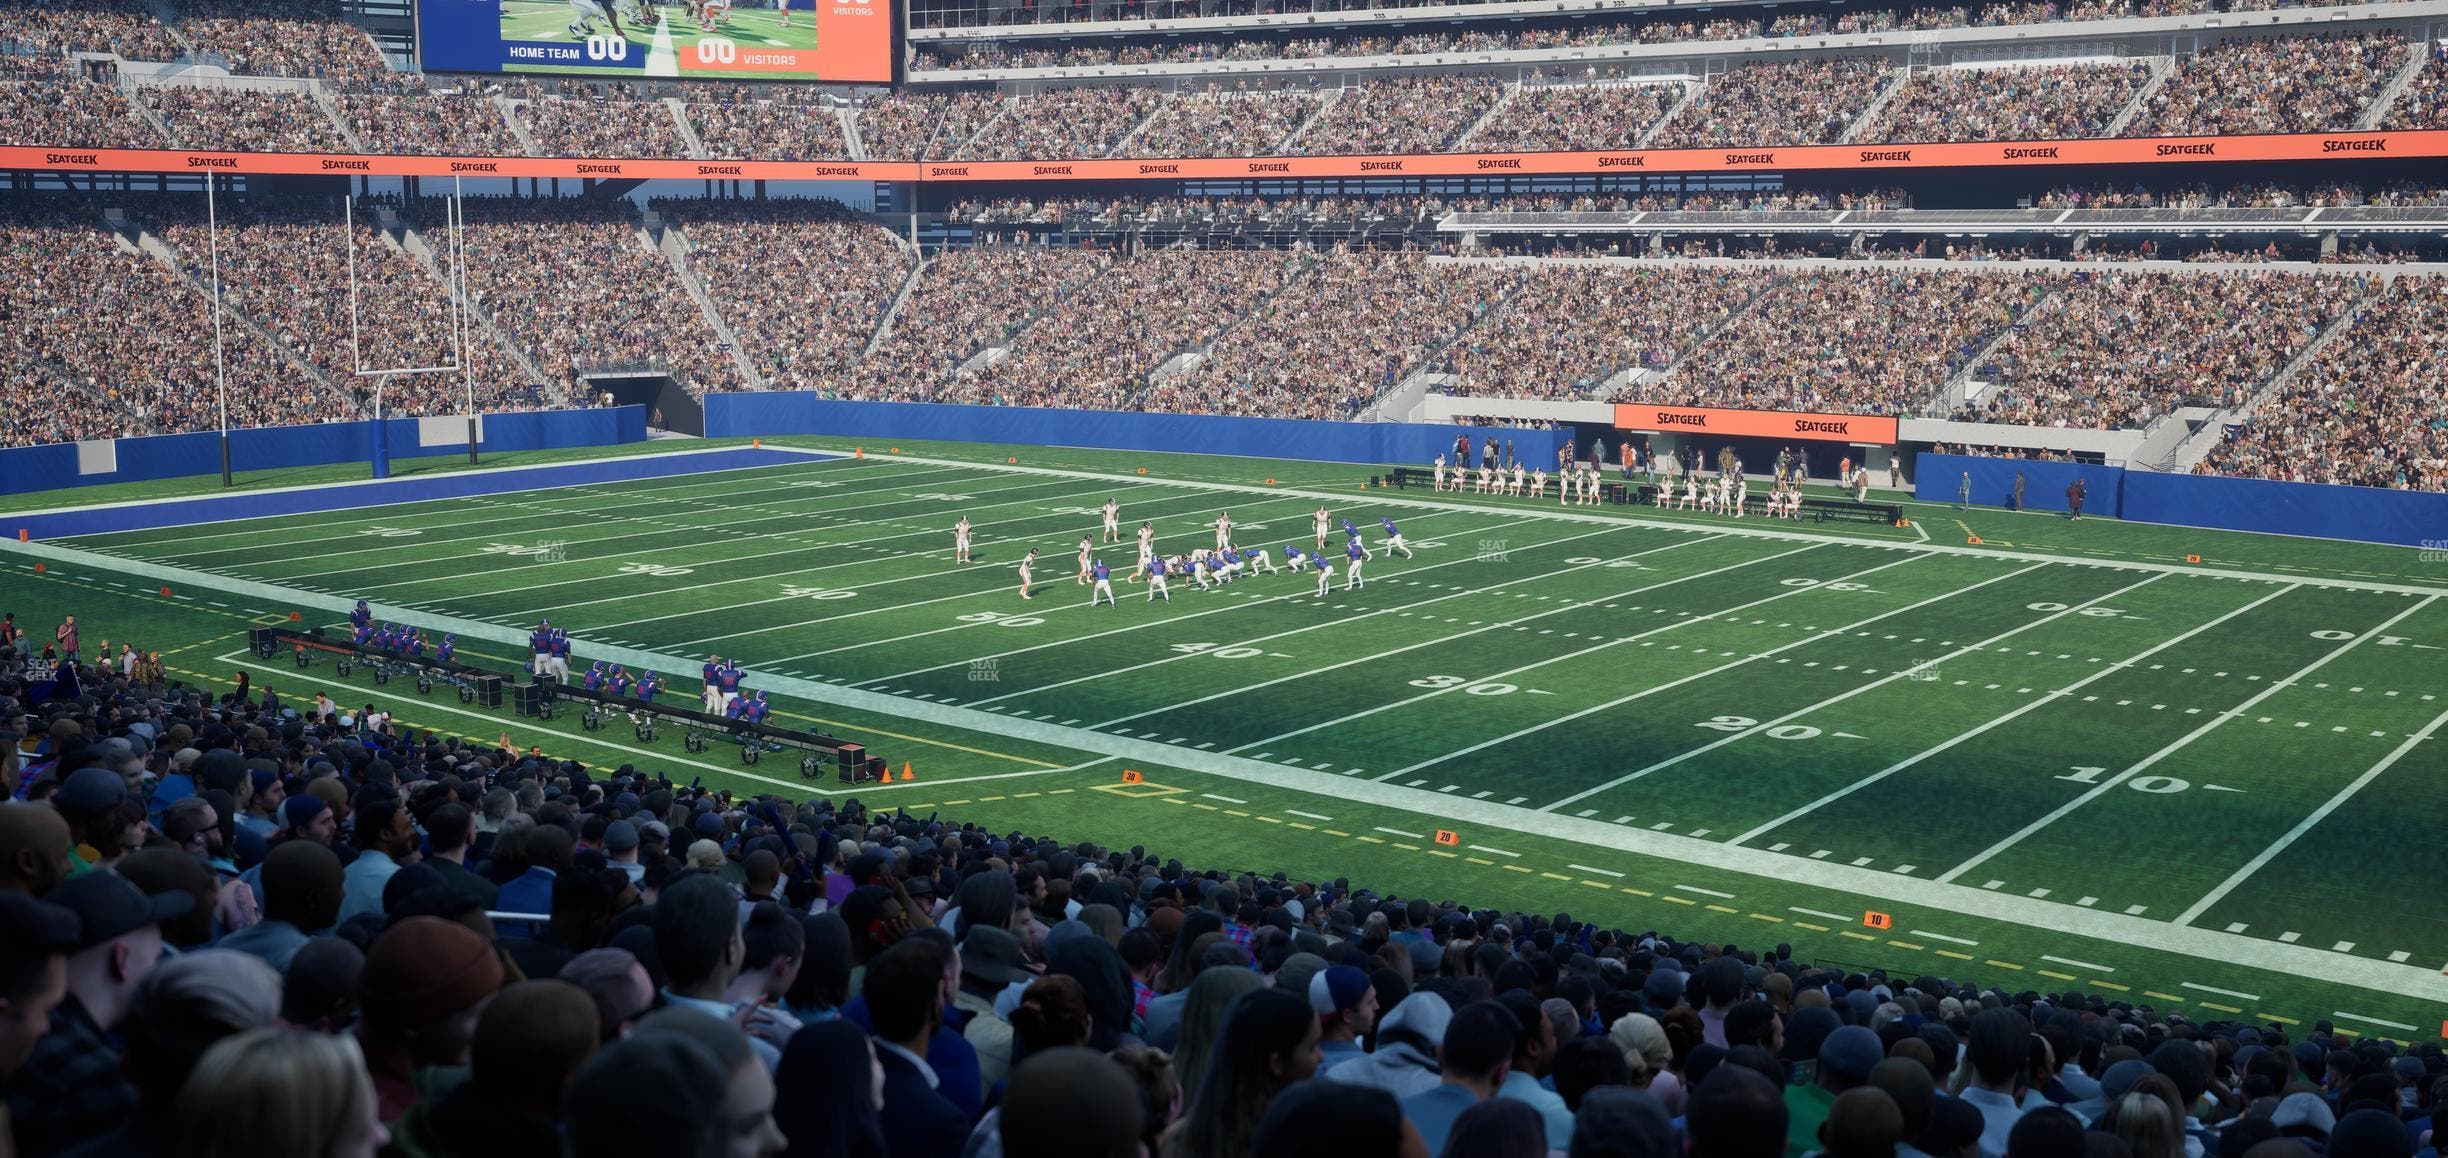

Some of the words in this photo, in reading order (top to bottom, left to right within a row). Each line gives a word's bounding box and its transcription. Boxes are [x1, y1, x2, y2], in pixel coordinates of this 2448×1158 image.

[833, 7, 873, 16] VISITORS
[510, 46, 545, 58] HOME
[547, 48, 580, 60] TEAM
[587, 34, 627, 61] 00
[697, 37, 736, 64] 00
[743, 54, 797, 66] VISITORS
[2156, 143, 2215, 157] SEATGEEK
[2322, 138, 2386, 153] SEATGEEK
[1725, 153, 1774, 165] SEATGEEK
[1860, 150, 1912, 163] SEATGEEK
[2003, 146, 2059, 160] SEATGEEK
[46, 153, 98, 166] SEATGEEK
[187, 156, 238, 168] SEATGEEK
[322, 159, 370, 171] SEATGEEK
[1360, 160, 1403, 171] SEATGEEK
[1477, 158, 1521, 170] SEATGEEK
[1598, 156, 1645, 168] SEATGEEK
[450, 162, 498, 173] SEATGEEK
[576, 164, 621, 174] SEATGEEK
[697, 165, 742, 175] SEATGEEK
[816, 167, 859, 177] SEATGEEK
[931, 167, 969, 177] SEATGEEK
[1033, 165, 1073, 176] SEATGEEK
[1139, 164, 1179, 174] SEATGEEK
[1248, 162, 1290, 173] SEATGEEK
[1657, 412, 1707, 427] SEATGEEK
[1794, 419, 1848, 435] SEATGEEK
[955, 611, 1046, 627] 50
[1169, 642, 1264, 659] 40
[1407, 675, 1520, 696] 30
[1692, 715, 1823, 740] 20
[1126, 772, 1136, 781] 30
[2052, 766, 2191, 794] 10
[1440, 831, 1452, 843] 20
[1871, 914, 1883, 925] 10
